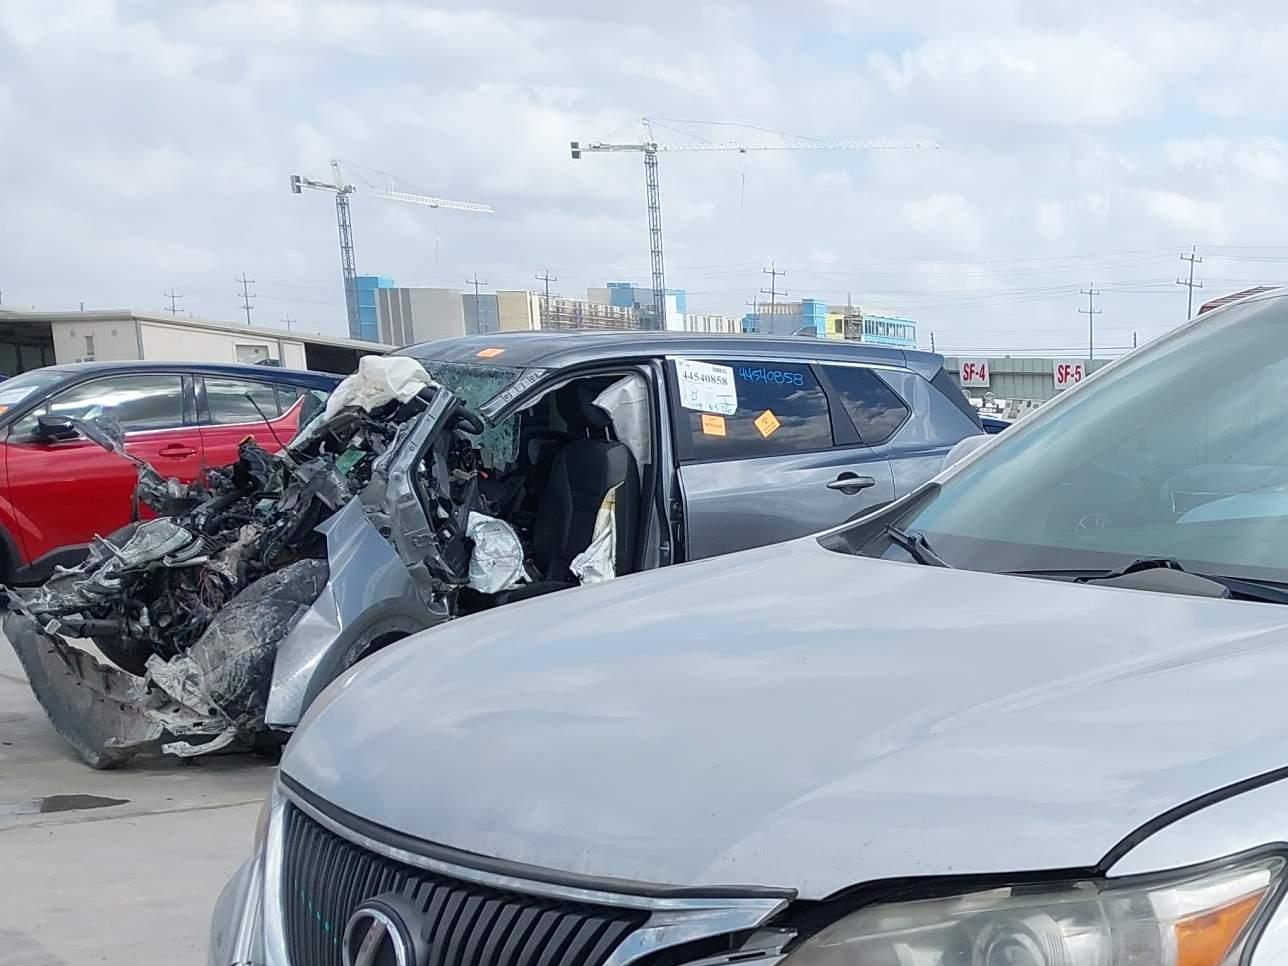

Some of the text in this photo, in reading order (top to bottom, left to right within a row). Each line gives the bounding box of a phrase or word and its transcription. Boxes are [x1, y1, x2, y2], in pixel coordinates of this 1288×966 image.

[682, 370, 728, 386] 44540858
[739, 366, 804, 386] 44540858
[962, 362, 986, 382] SF-4
[1057, 364, 1082, 384] SF-5
